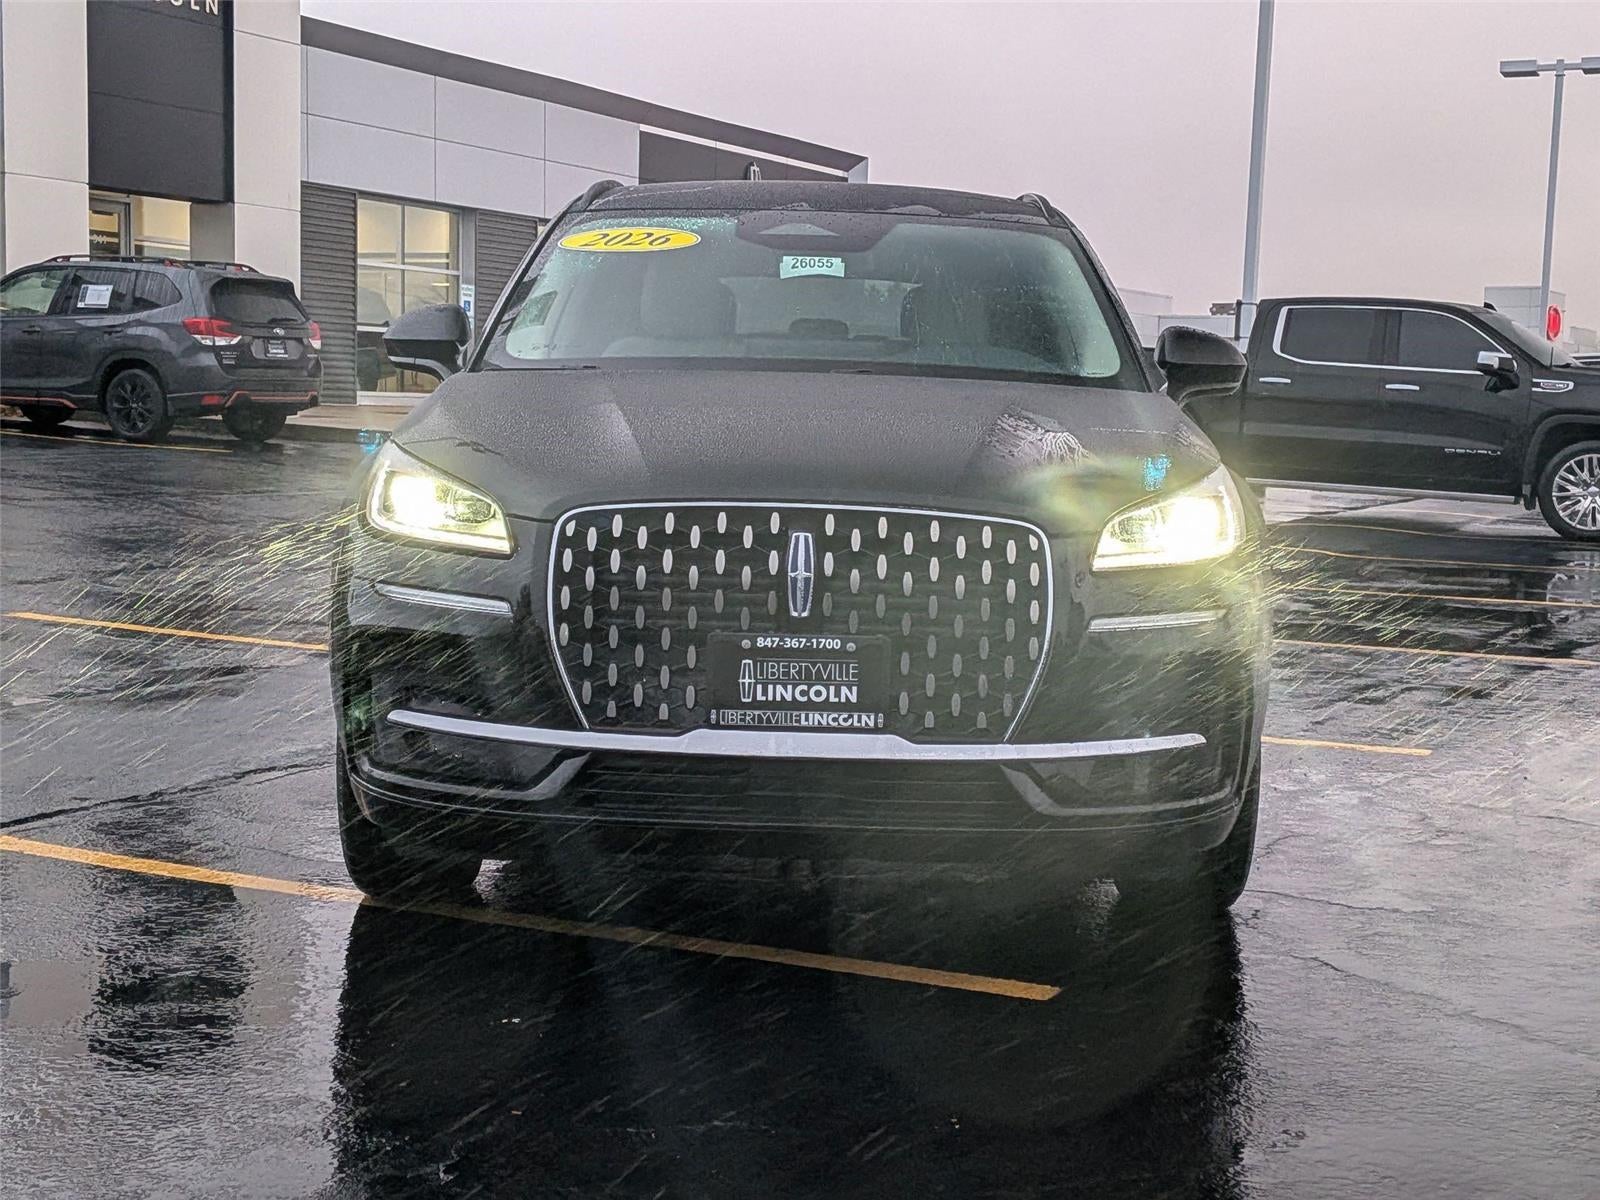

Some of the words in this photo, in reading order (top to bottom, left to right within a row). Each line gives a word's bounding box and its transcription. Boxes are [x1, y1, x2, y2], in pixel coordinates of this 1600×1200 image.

[578, 231, 675, 247] 2026
[790, 257, 834, 269] 26055
[756, 637, 842, 650] 847-367-1700
[757, 662, 859, 682] LIBERTYVILLE
[756, 684, 858, 703] LINCOLN
